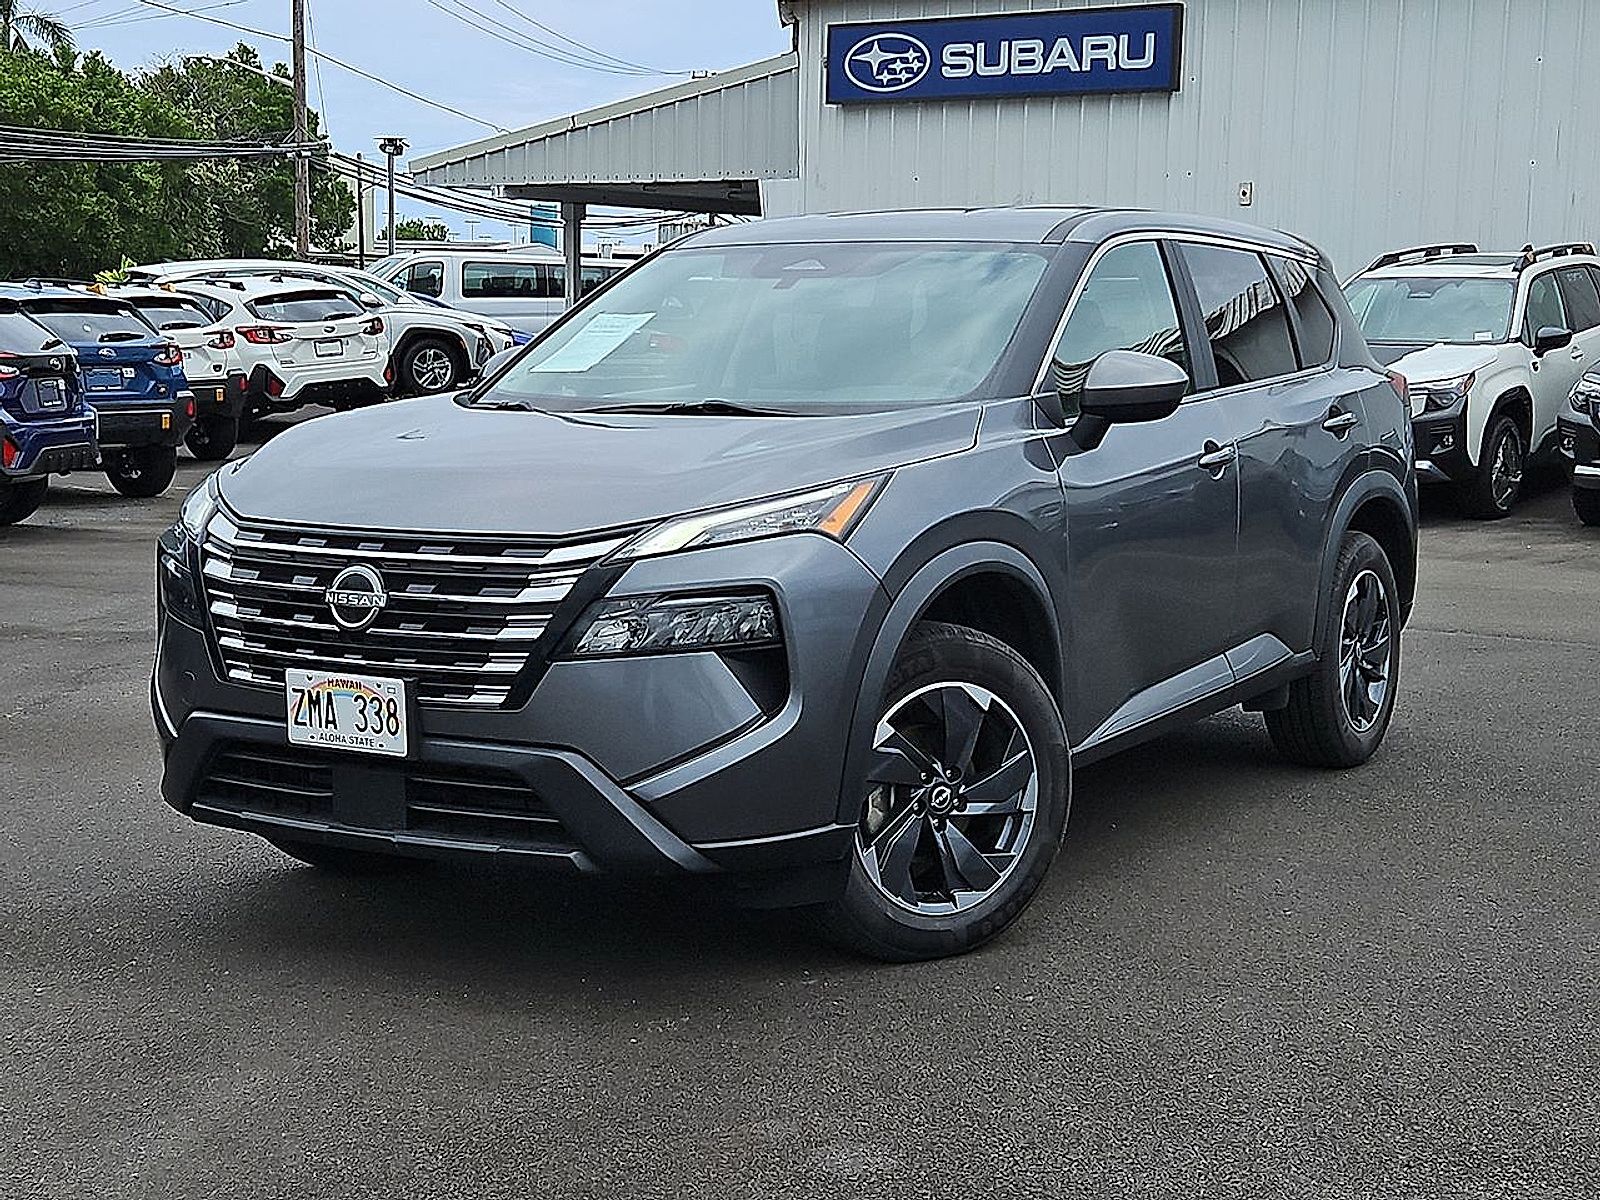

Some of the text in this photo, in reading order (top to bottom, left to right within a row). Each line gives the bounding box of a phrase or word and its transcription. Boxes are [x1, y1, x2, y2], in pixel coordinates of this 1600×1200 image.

[941, 32, 1156, 78] SUBARU
[325, 591, 385, 607] NISSAN
[327, 678, 363, 690] HAWAII
[291, 687, 400, 736] ZMA 338
[318, 733, 375, 747] ALOHA STATE
